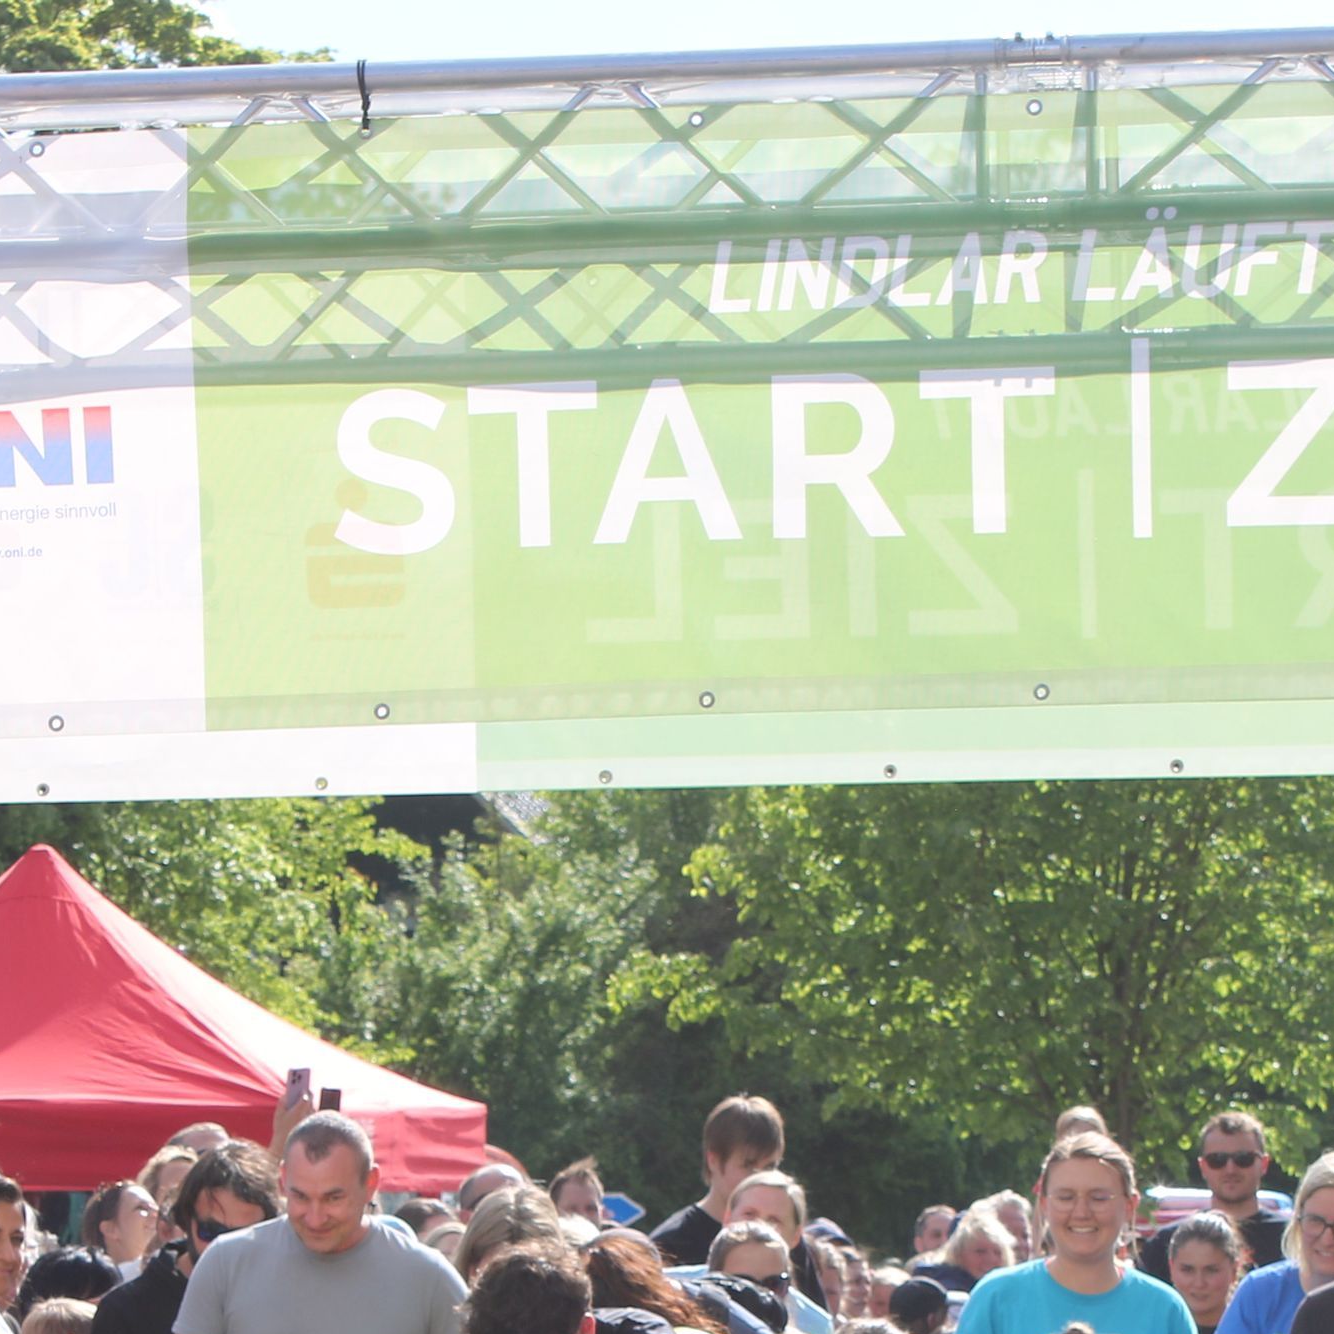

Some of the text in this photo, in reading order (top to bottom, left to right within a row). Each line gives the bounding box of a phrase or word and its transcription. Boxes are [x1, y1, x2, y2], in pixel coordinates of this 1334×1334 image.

[708, 229, 1048, 315] LINDLAR
[333, 366, 1056, 556] START
[54, 500, 118, 521] sinnvoll
